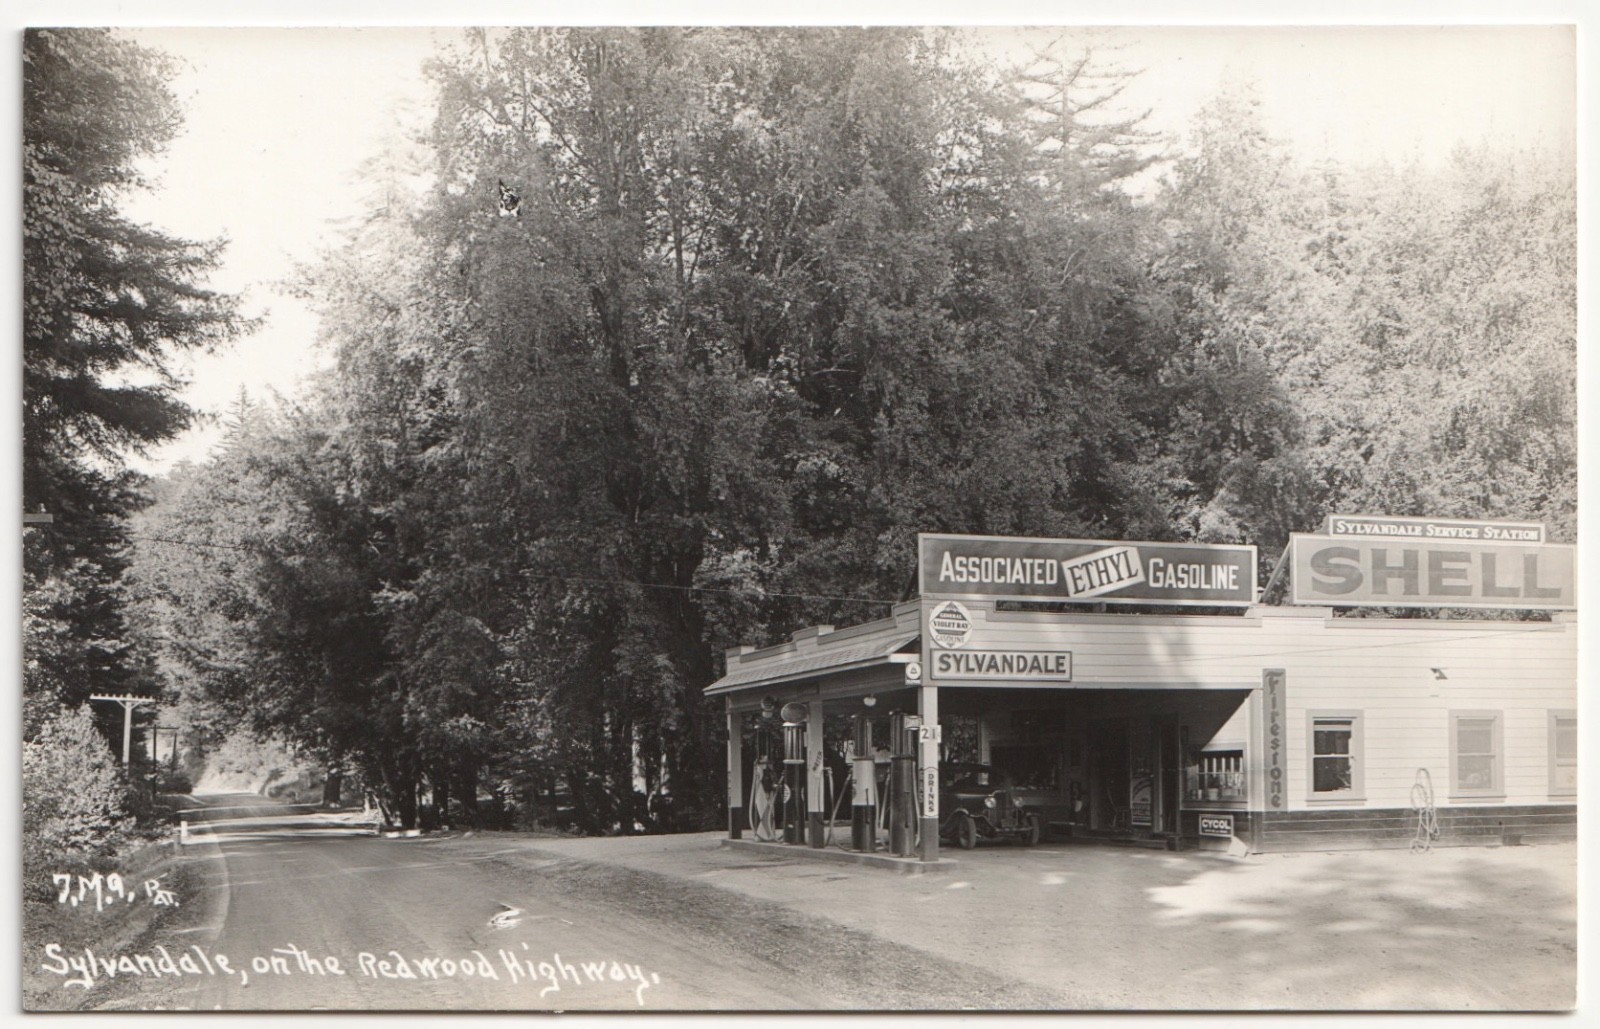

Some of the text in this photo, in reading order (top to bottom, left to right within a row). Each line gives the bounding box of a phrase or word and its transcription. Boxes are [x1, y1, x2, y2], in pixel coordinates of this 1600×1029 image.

[1336, 521, 1539, 541] SYLVANDALE SERVICE STATION
[939, 550, 1239, 595] ASSOCIATED ETHYL GASOLINE
[1310, 546, 1562, 599] SHELL
[933, 620, 968, 630] VIOLET RAY
[938, 653, 1066, 674] SYLVANDALE
[1265, 671, 1284, 808] Firestone
[1202, 818, 1231, 830] CYCOL
